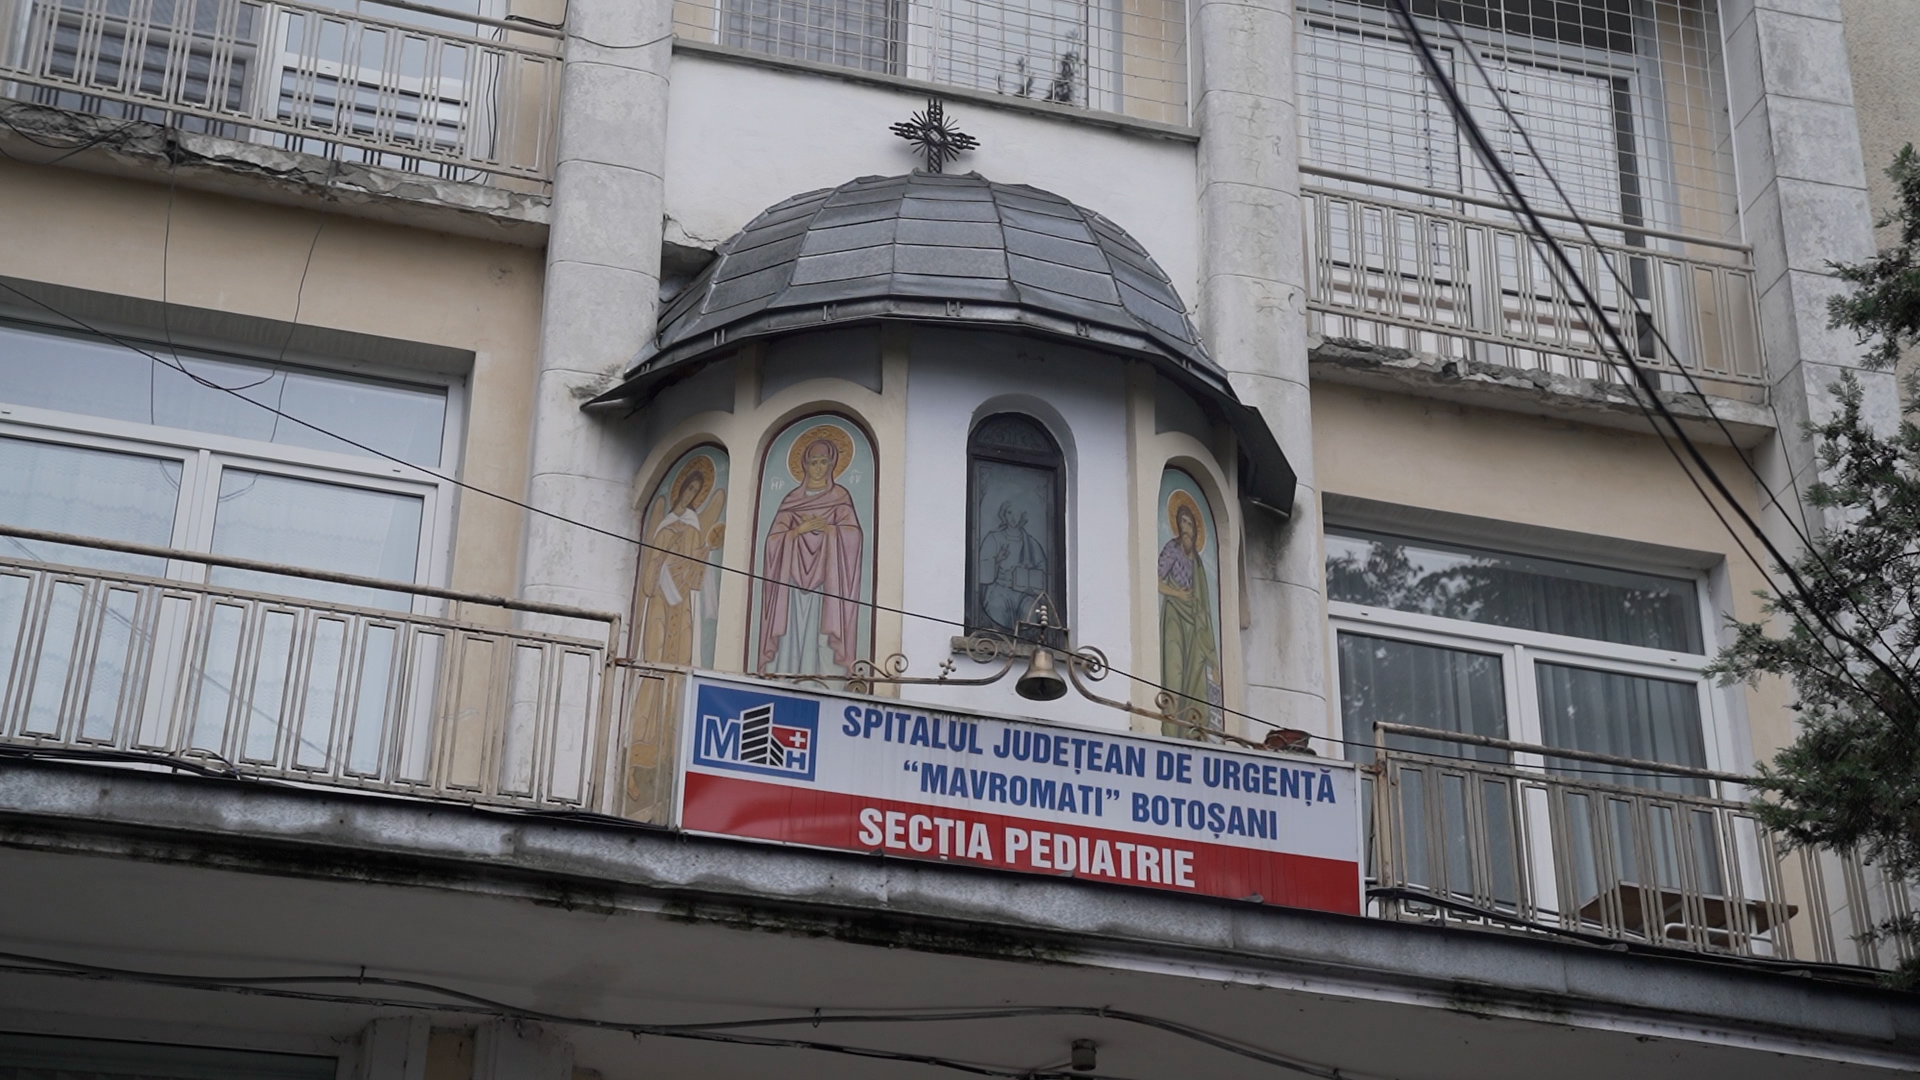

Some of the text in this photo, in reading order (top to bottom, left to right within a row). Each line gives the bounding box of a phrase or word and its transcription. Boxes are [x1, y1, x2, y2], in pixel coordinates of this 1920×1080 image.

[842, 706, 1335, 807] SPITALUL JUDEȚEAN DE URGENȚĂ
[903, 762, 1279, 840] “MAVROMATI” BOTOȘANI
[858, 807, 1196, 888] SECȚIA PEDIATRIE
